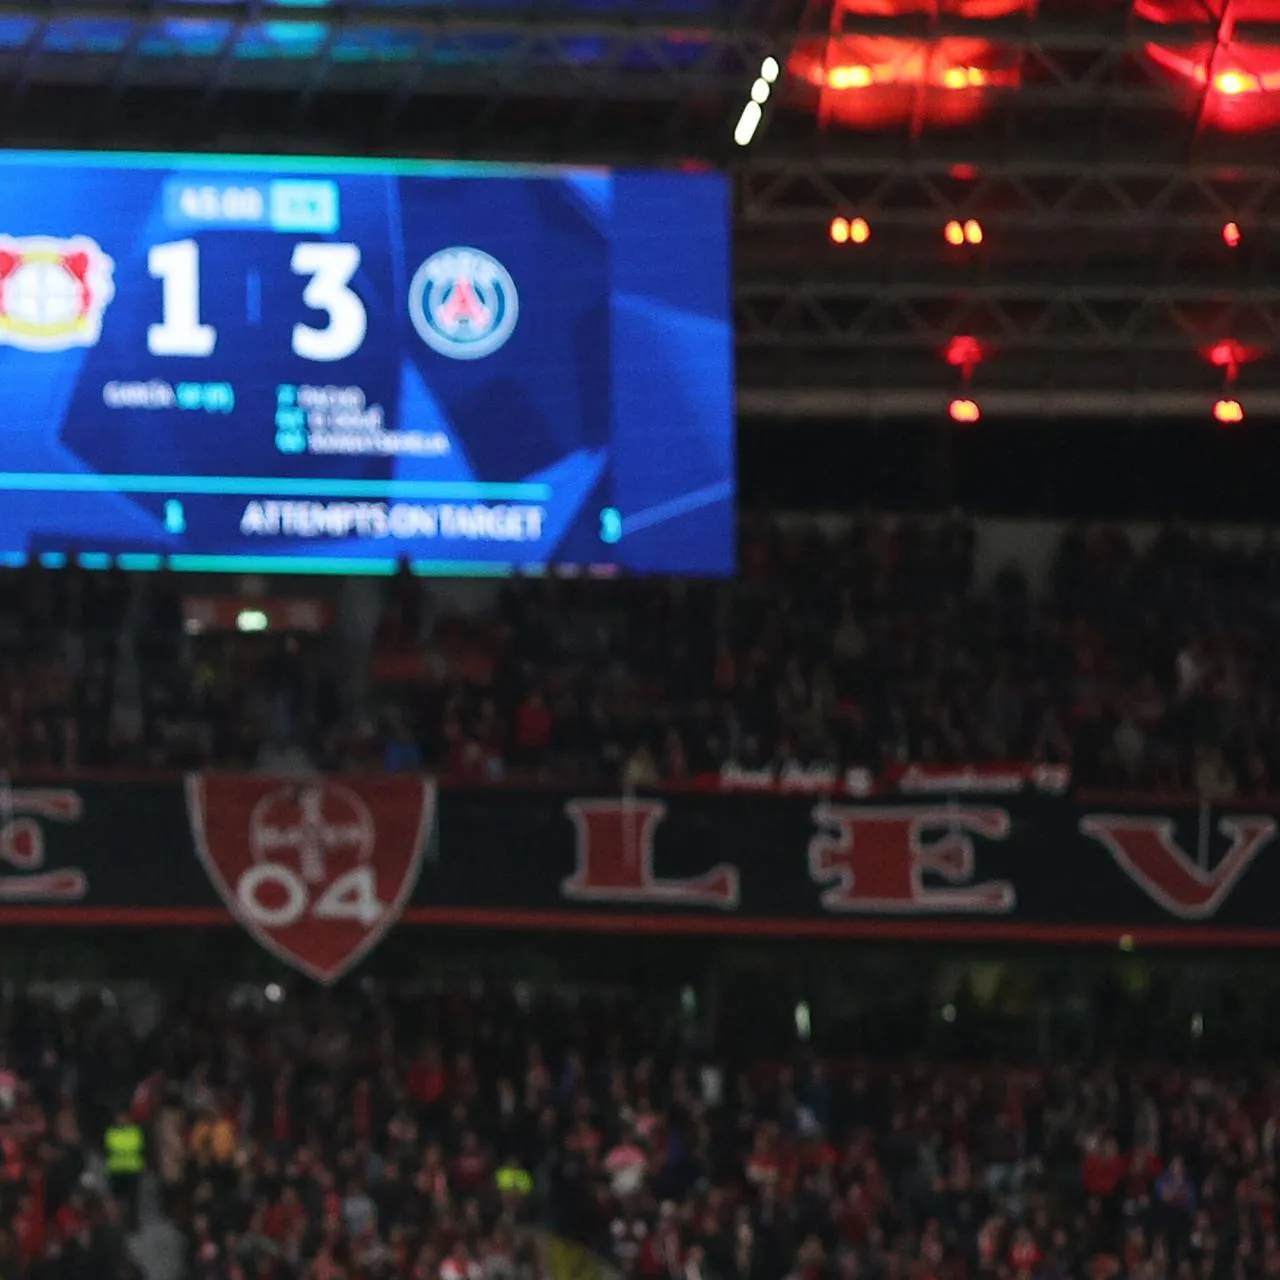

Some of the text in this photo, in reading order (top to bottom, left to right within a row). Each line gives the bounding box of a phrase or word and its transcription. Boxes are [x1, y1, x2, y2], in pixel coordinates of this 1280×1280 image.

[147, 239, 366, 361] 1 3
[236, 860, 385, 927] 04
